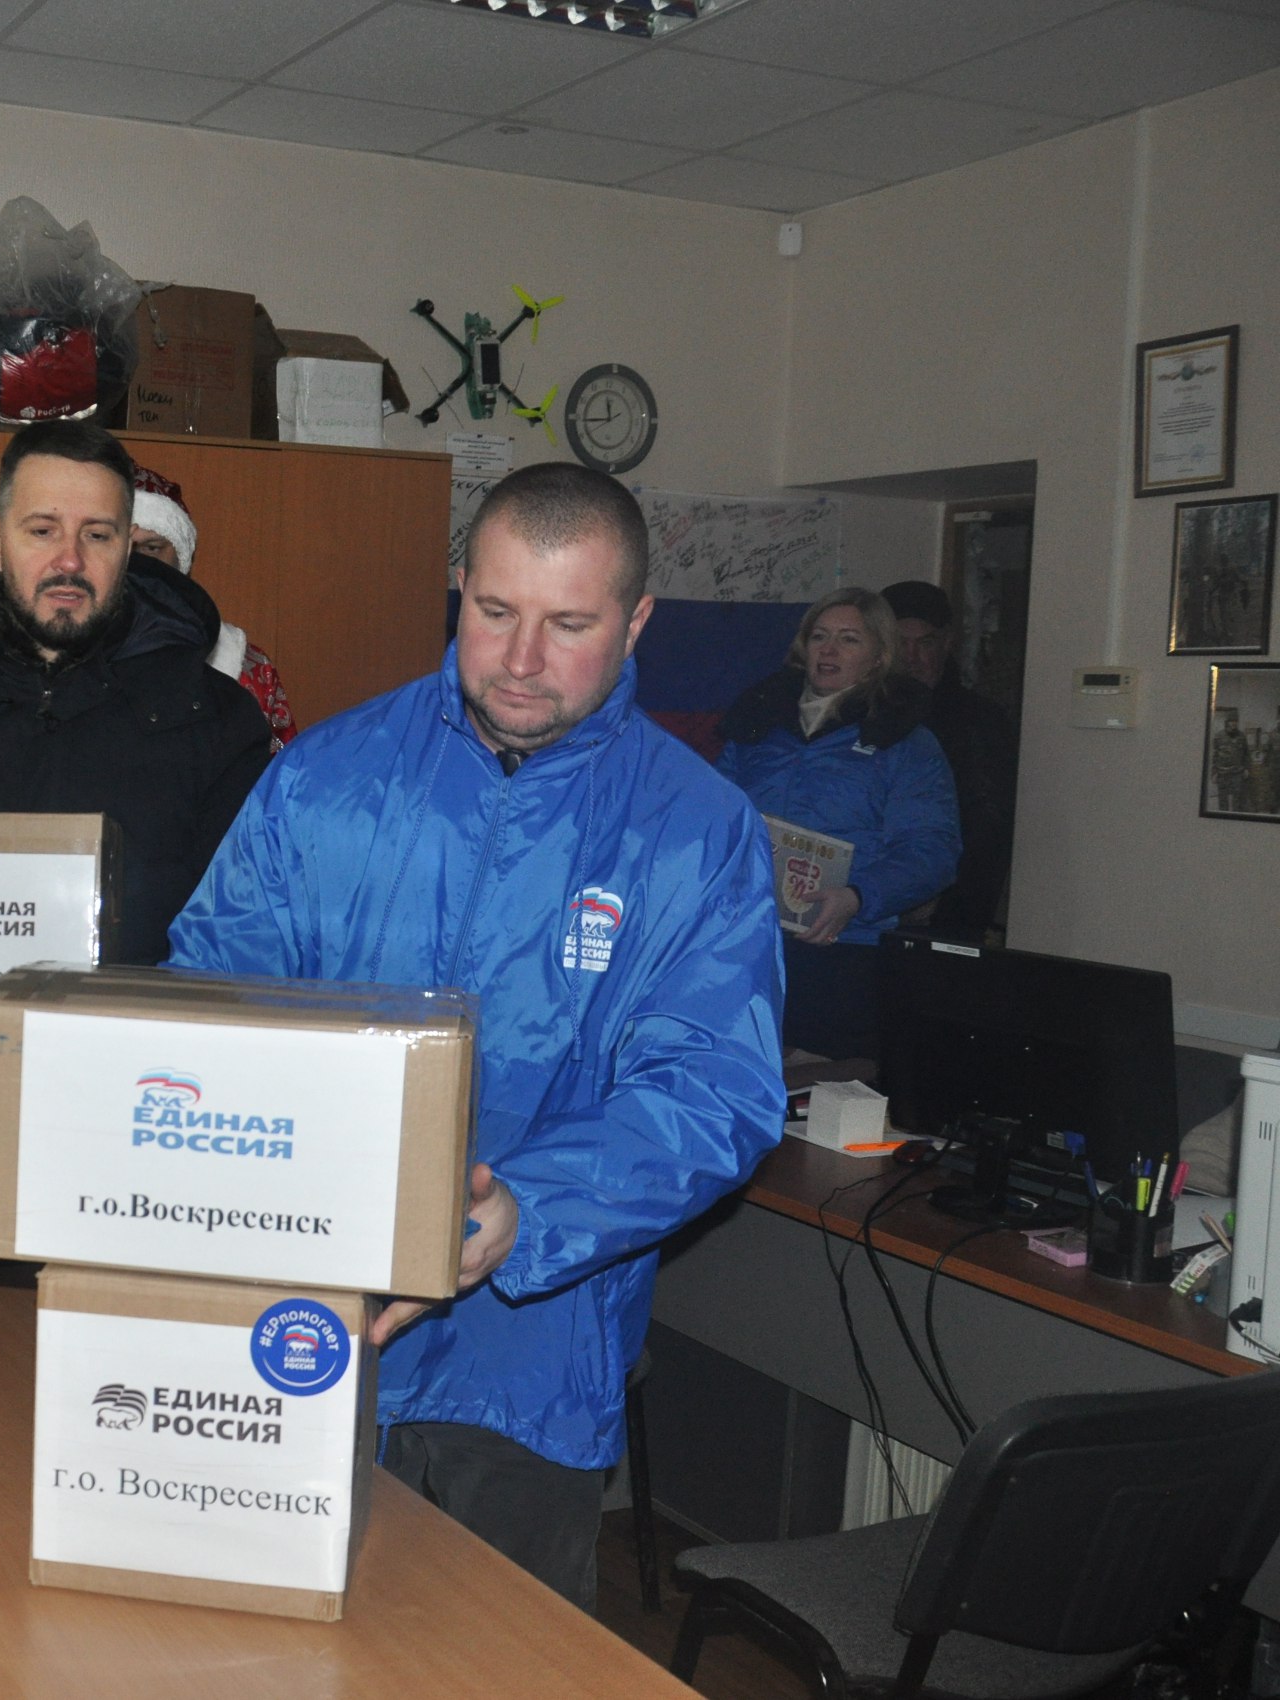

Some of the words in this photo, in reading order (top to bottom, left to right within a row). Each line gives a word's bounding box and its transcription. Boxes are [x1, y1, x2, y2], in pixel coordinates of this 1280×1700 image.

[132, 1105, 295, 1136] ЕДИНАЯ
[131, 1129, 294, 1160] РОССИЯ
[283, 1356, 316, 1364] ЕДИНАЯ
[283, 1362, 316, 1371] РОССИЯ
[152, 1387, 283, 1417] ЕДИНАЯ
[151, 1413, 282, 1444] РОССИЯ
[52, 1467, 105, 1493] г.о.
[118, 1467, 332, 1517] Воскресенск
